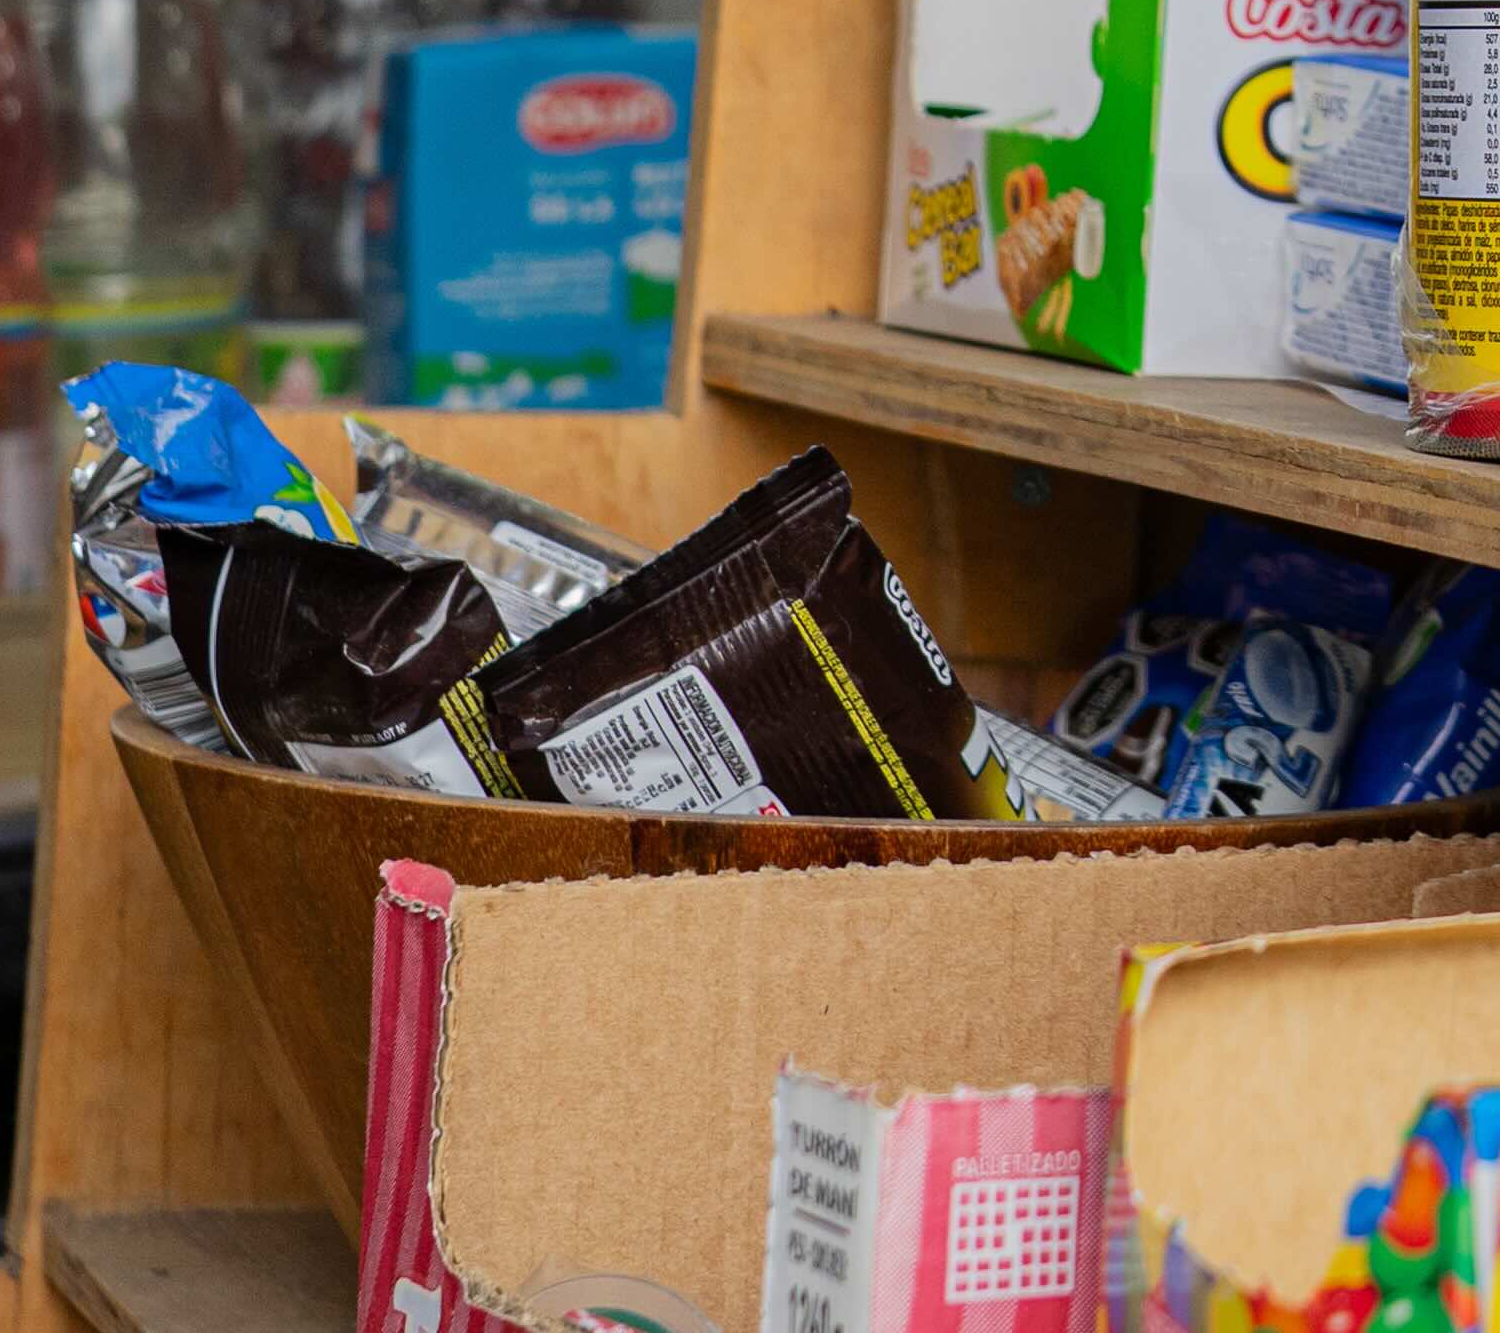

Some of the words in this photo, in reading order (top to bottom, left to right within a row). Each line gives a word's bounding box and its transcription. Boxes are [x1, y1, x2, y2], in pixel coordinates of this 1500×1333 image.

[1483, 12, 1499, 24] 100g
[883, 561, 954, 686] Costa
[789, 1119, 861, 1173] TURRÓN
[956, 1149, 1082, 1176] PALLETIZADO
[790, 1168, 813, 1195] DE
